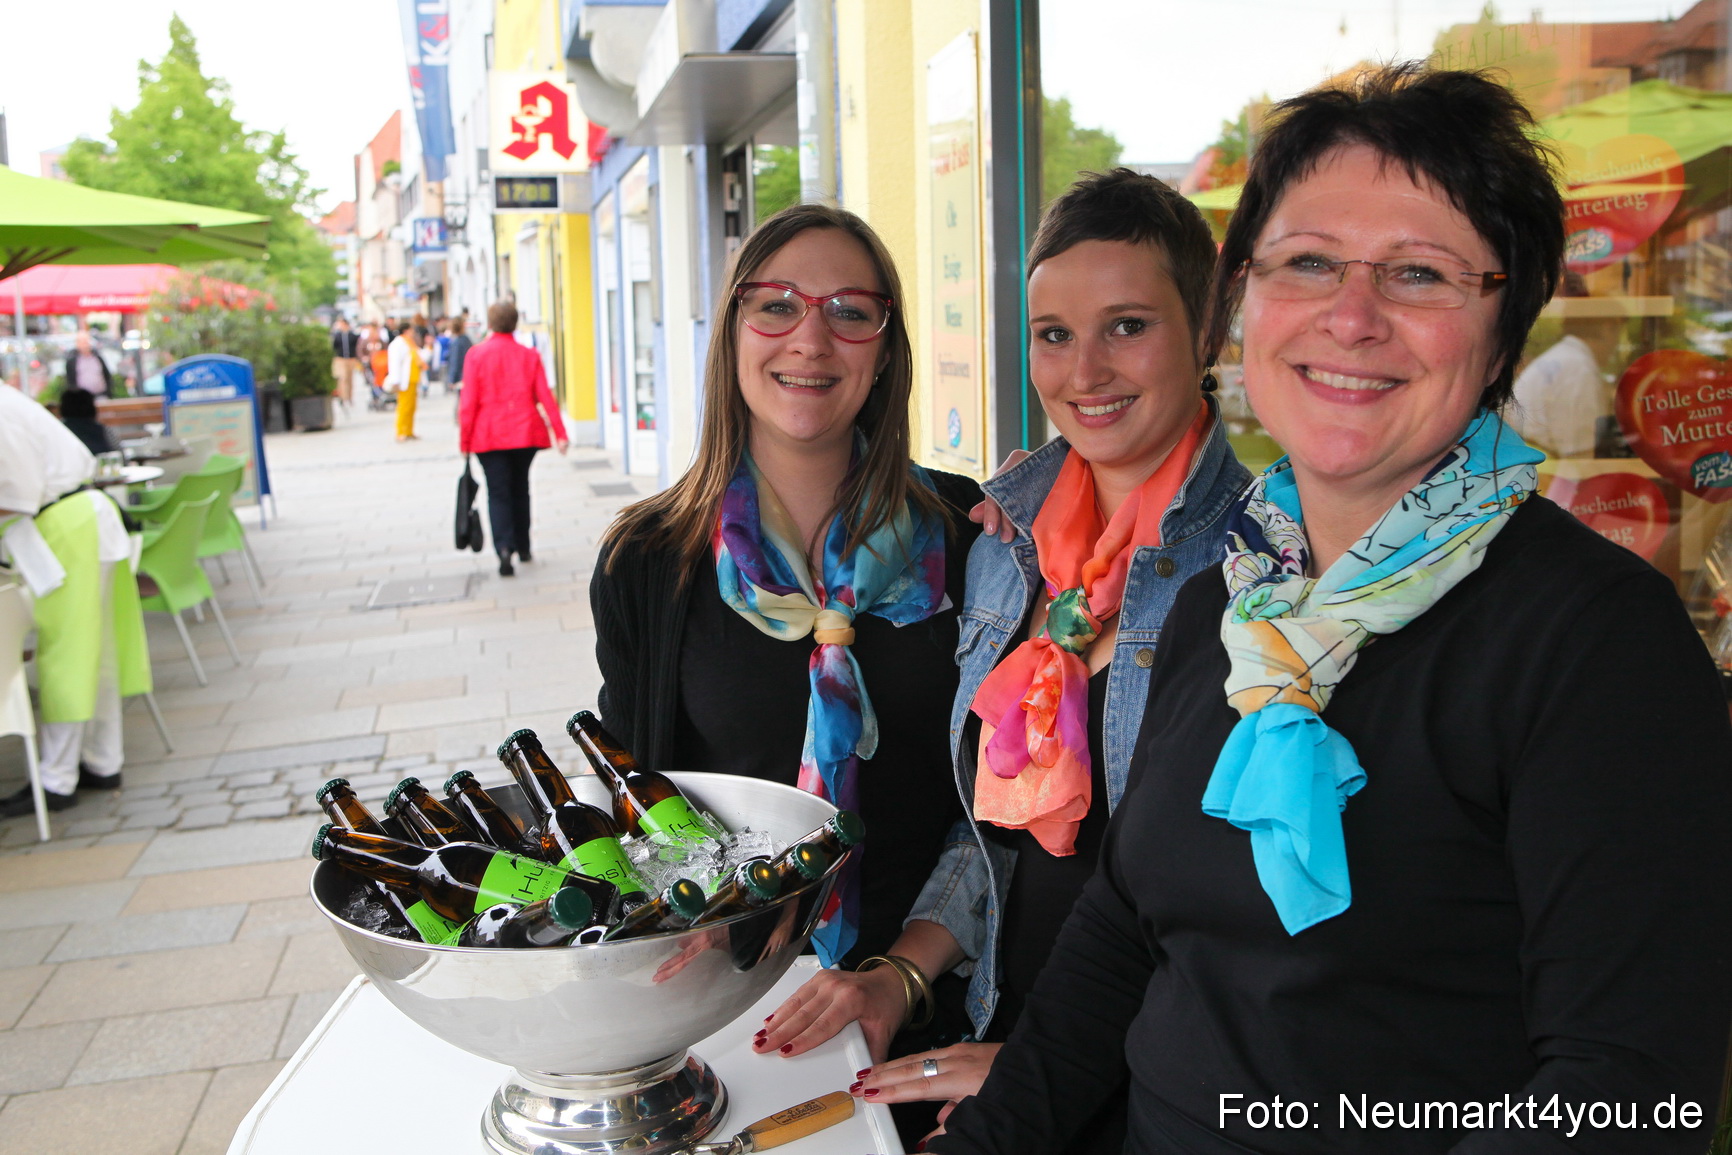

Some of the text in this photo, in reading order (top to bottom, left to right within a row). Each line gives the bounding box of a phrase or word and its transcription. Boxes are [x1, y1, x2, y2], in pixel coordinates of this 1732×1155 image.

[1563, 191, 1648, 219] uttertag
[1638, 388, 1692, 414] Tolle
[1687, 404, 1723, 421] zum
[1693, 461, 1732, 490] FAS
[1695, 455, 1721, 472] vom
[1562, 491, 1650, 516] eschenke
